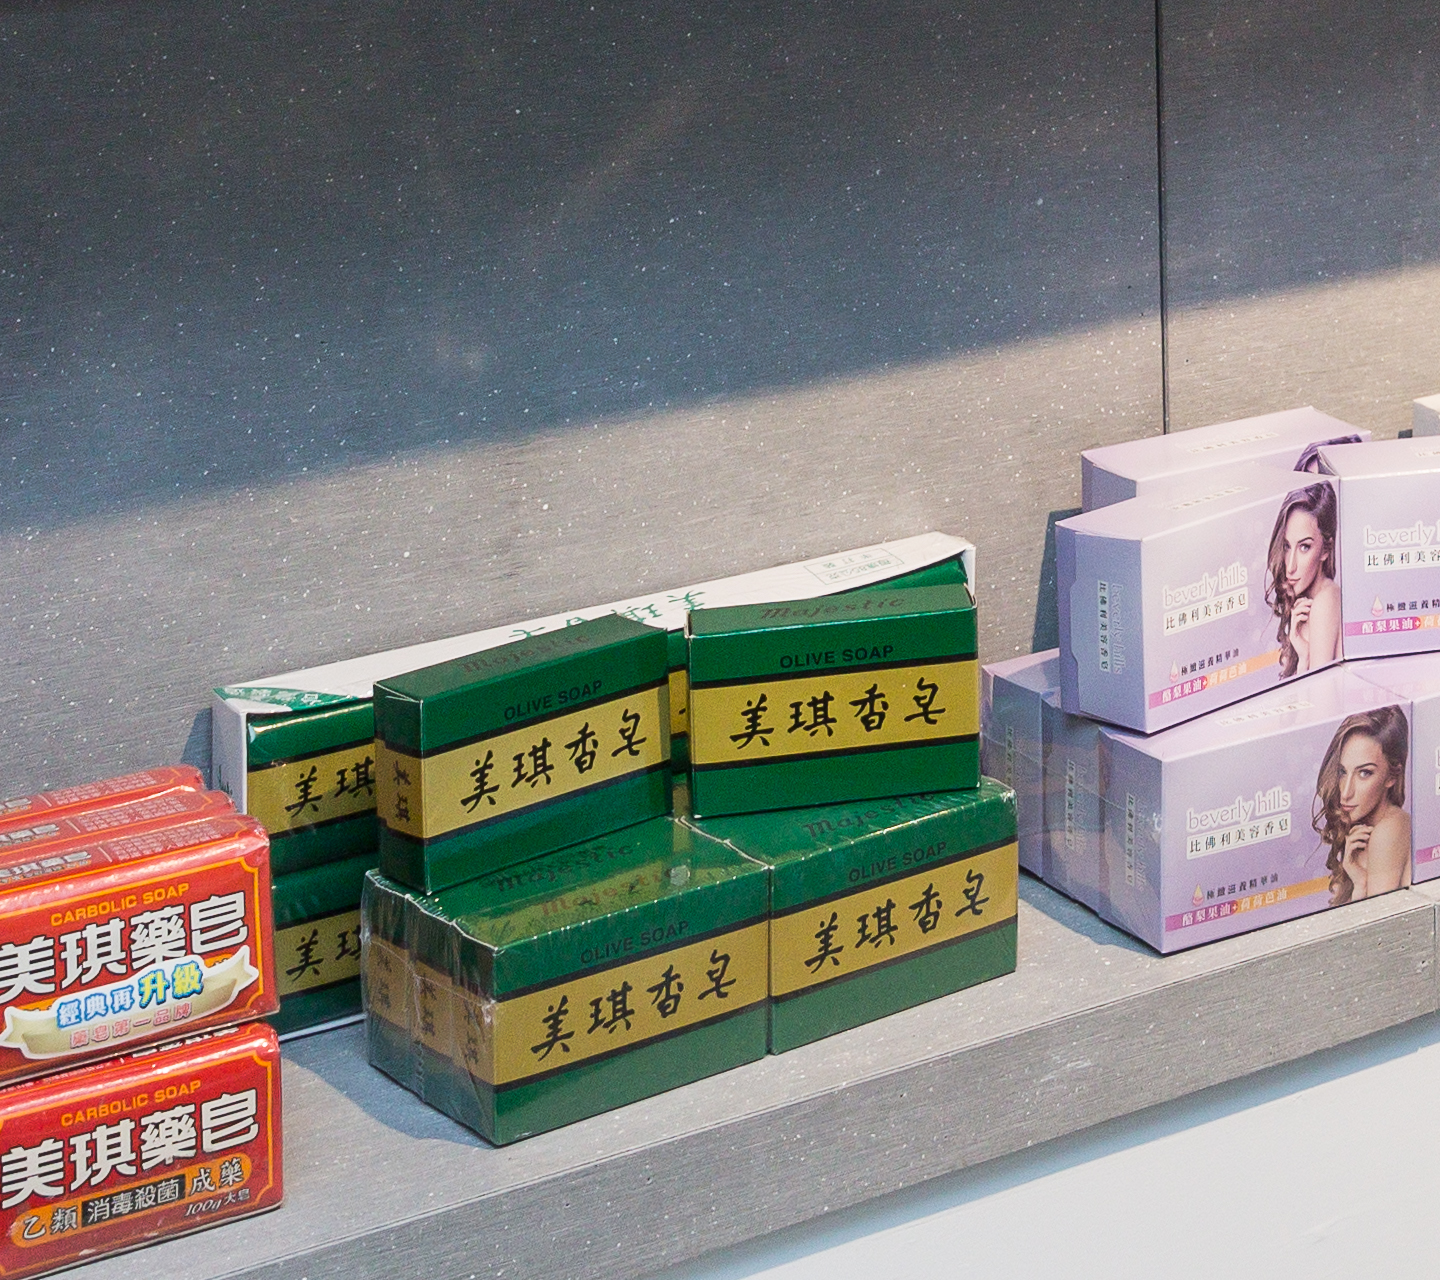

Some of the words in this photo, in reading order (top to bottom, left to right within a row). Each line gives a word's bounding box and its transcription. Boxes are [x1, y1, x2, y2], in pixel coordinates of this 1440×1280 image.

[1366, 522, 1434, 547] beverly
[1165, 594, 1247, 630] 比佛利美容香皂
[779, 652, 838, 670] OLIVE
[841, 644, 895, 664] SOAP
[504, 695, 554, 721] OLIVE
[559, 680, 604, 706] SOAP
[729, 678, 946, 749] 美琪香皂
[460, 709, 649, 813] 美琪香皂
[1188, 795, 1253, 832] beverly
[1256, 787, 1290, 814] hills
[1189, 818, 1289, 854] 比佛利美容香皂
[51, 895, 138, 927] CARBOLIC
[142, 883, 189, 904] SOAP
[804, 868, 990, 974] 美琪香皂
[531, 949, 738, 1065] 美琪香皂
[1, 1088, 259, 1210] 美琪藥皂
[22, 1206, 78, 1241] 乙類
[87, 1180, 184, 1222] 消毒殺菌
[190, 1159, 244, 1195] 成藥
[184, 1199, 223, 1218] 100g
